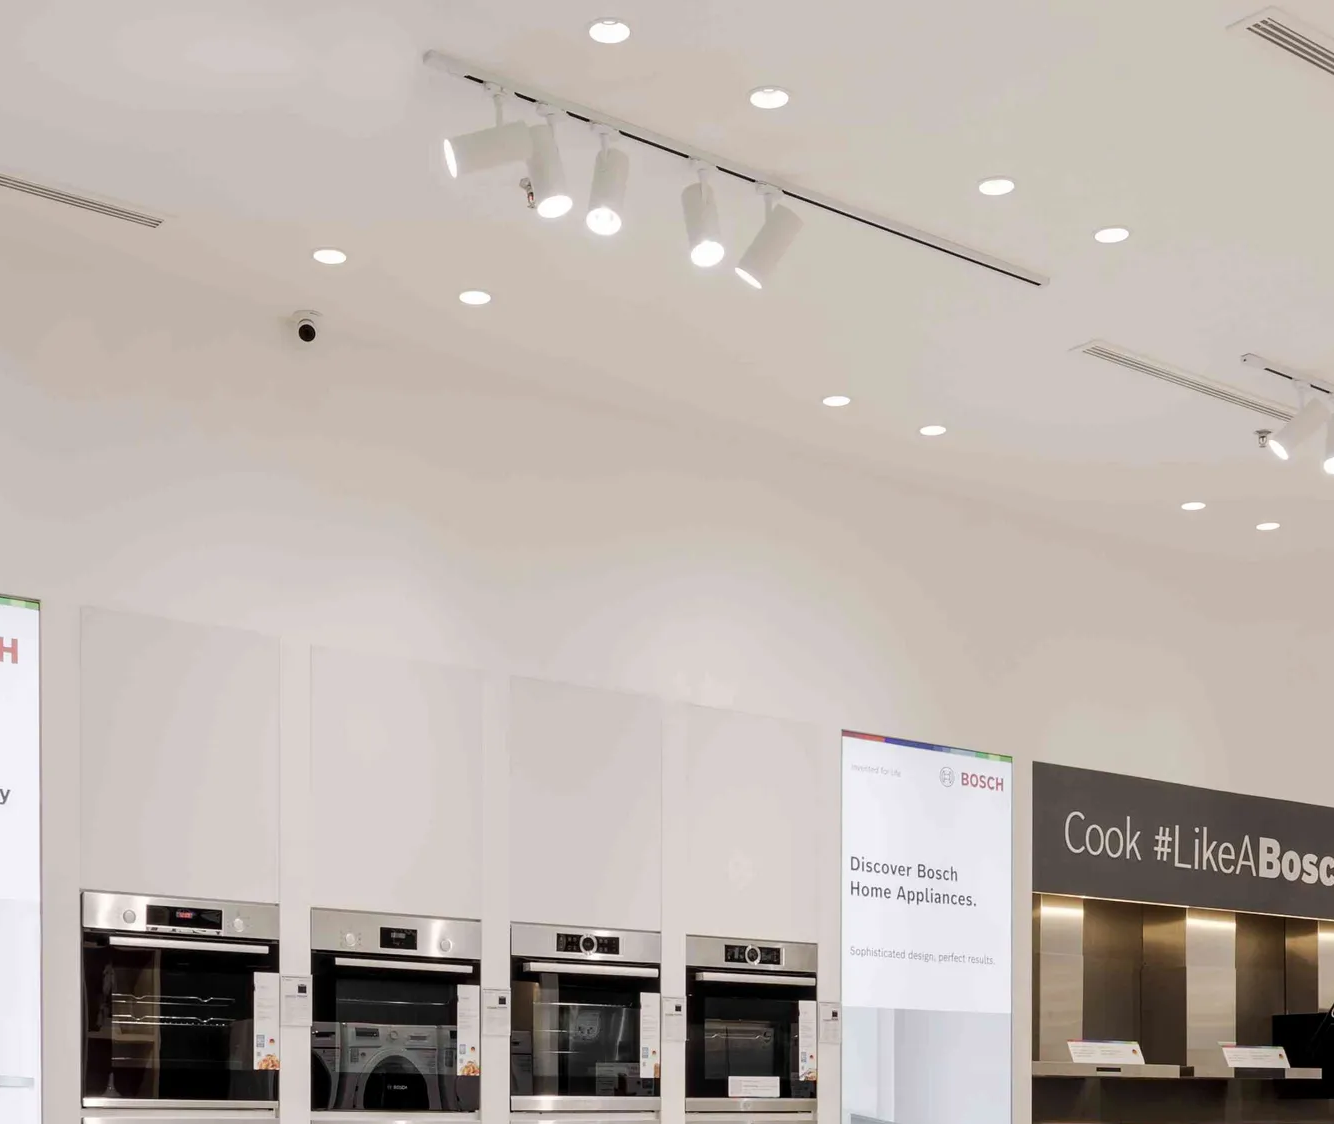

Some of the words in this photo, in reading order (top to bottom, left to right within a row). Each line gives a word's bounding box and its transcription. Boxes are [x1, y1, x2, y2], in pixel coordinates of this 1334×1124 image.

[961, 772, 1004, 792] BOSCH
[1064, 811, 1142, 861] Cook
[850, 856, 912, 877] Discover
[917, 863, 958, 882] Bosch
[850, 880, 892, 899] Home
[896, 886, 978, 907] Appliances.
[850, 945, 906, 961] Sophisticated
[907, 949, 936, 963] design,
[938, 951, 966, 964] perfect
[967, 953, 996, 966] results.
